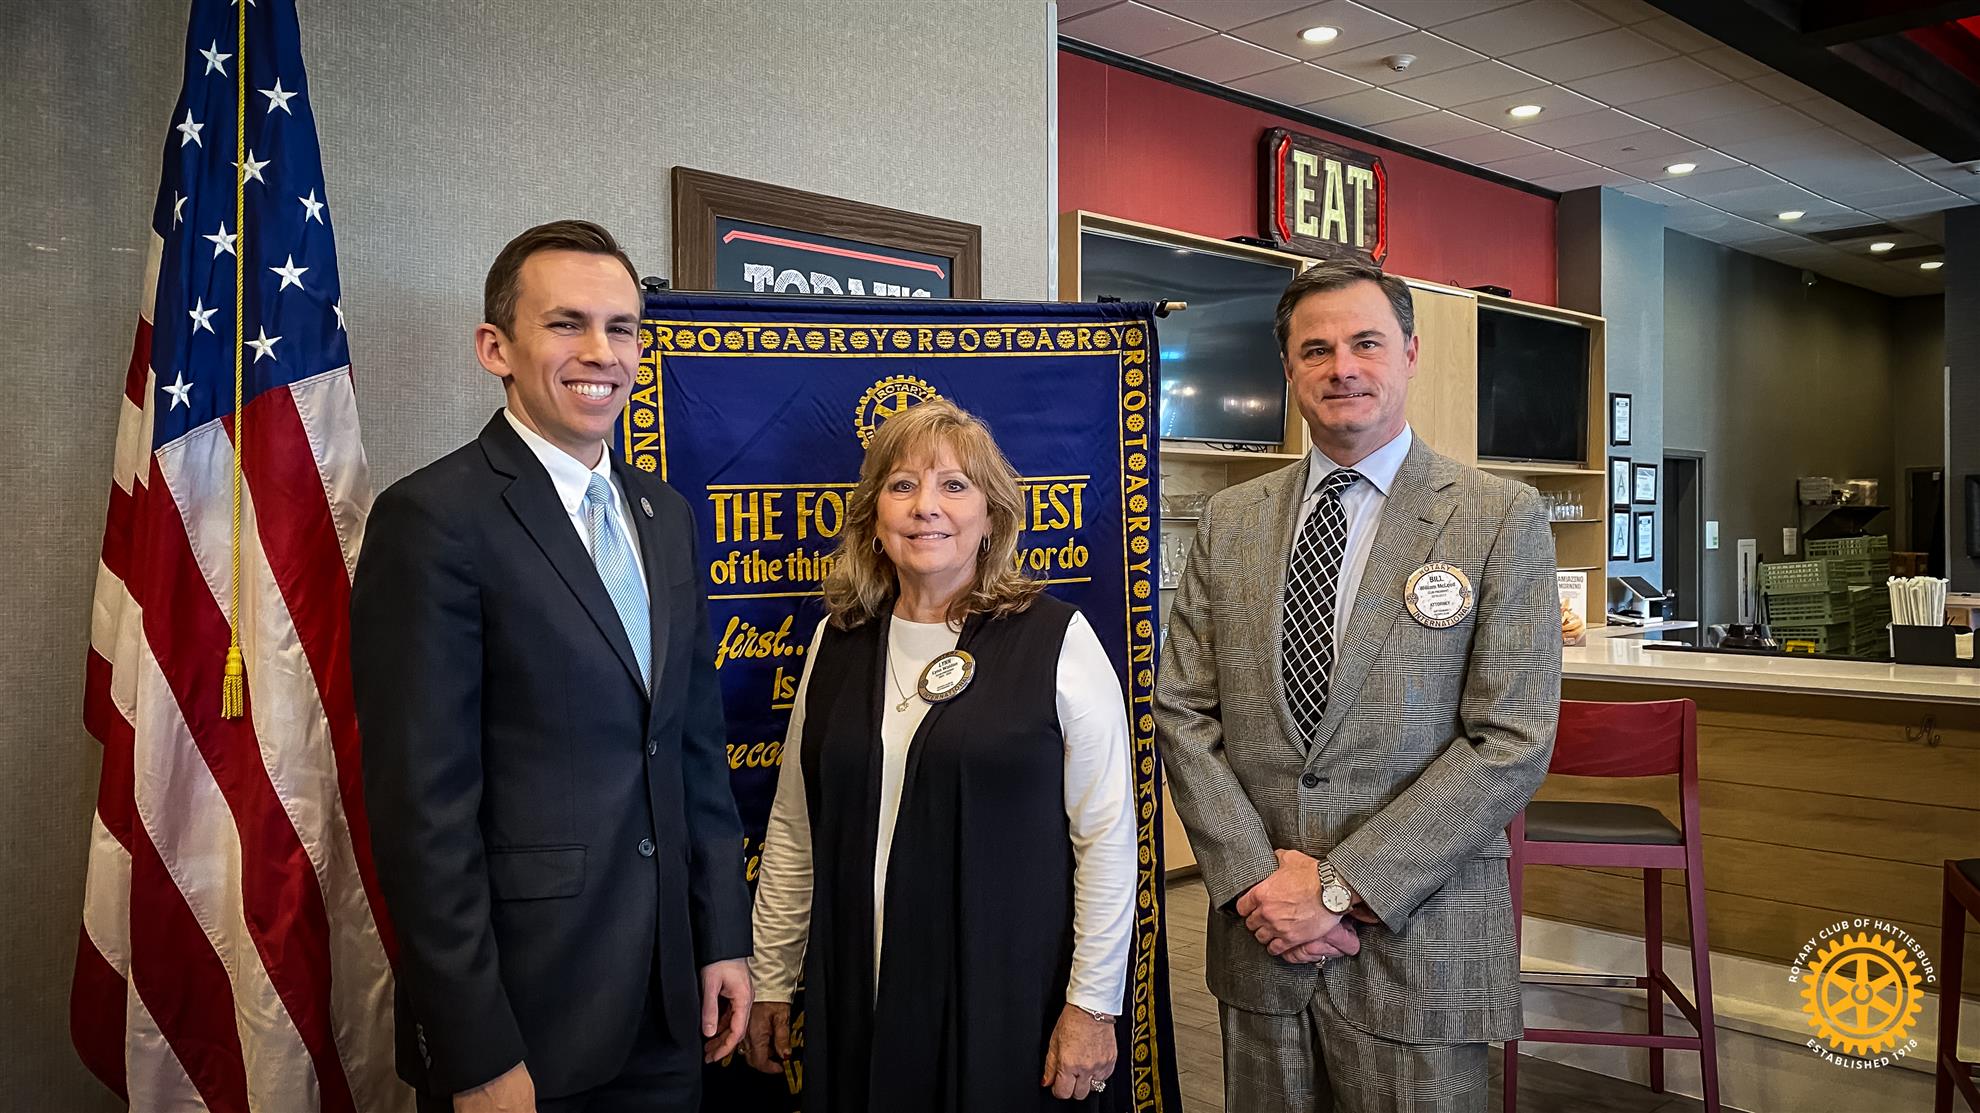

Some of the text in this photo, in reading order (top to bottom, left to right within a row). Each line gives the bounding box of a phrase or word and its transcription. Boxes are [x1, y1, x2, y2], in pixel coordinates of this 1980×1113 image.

[1293, 149, 1374, 248] EAT
[877, 384, 928, 399] ROTARY
[708, 491, 784, 543] THE
[710, 550, 741, 585] of
[740, 549, 783, 584] the
[785, 547, 835, 582] thin
[1029, 547, 1058, 571] or
[1058, 536, 1089, 570] do
[1419, 563, 1451, 574] ROTARY
[1429, 575, 1444, 583] BILL
[1413, 606, 1471, 627] INTERNATIONAL
